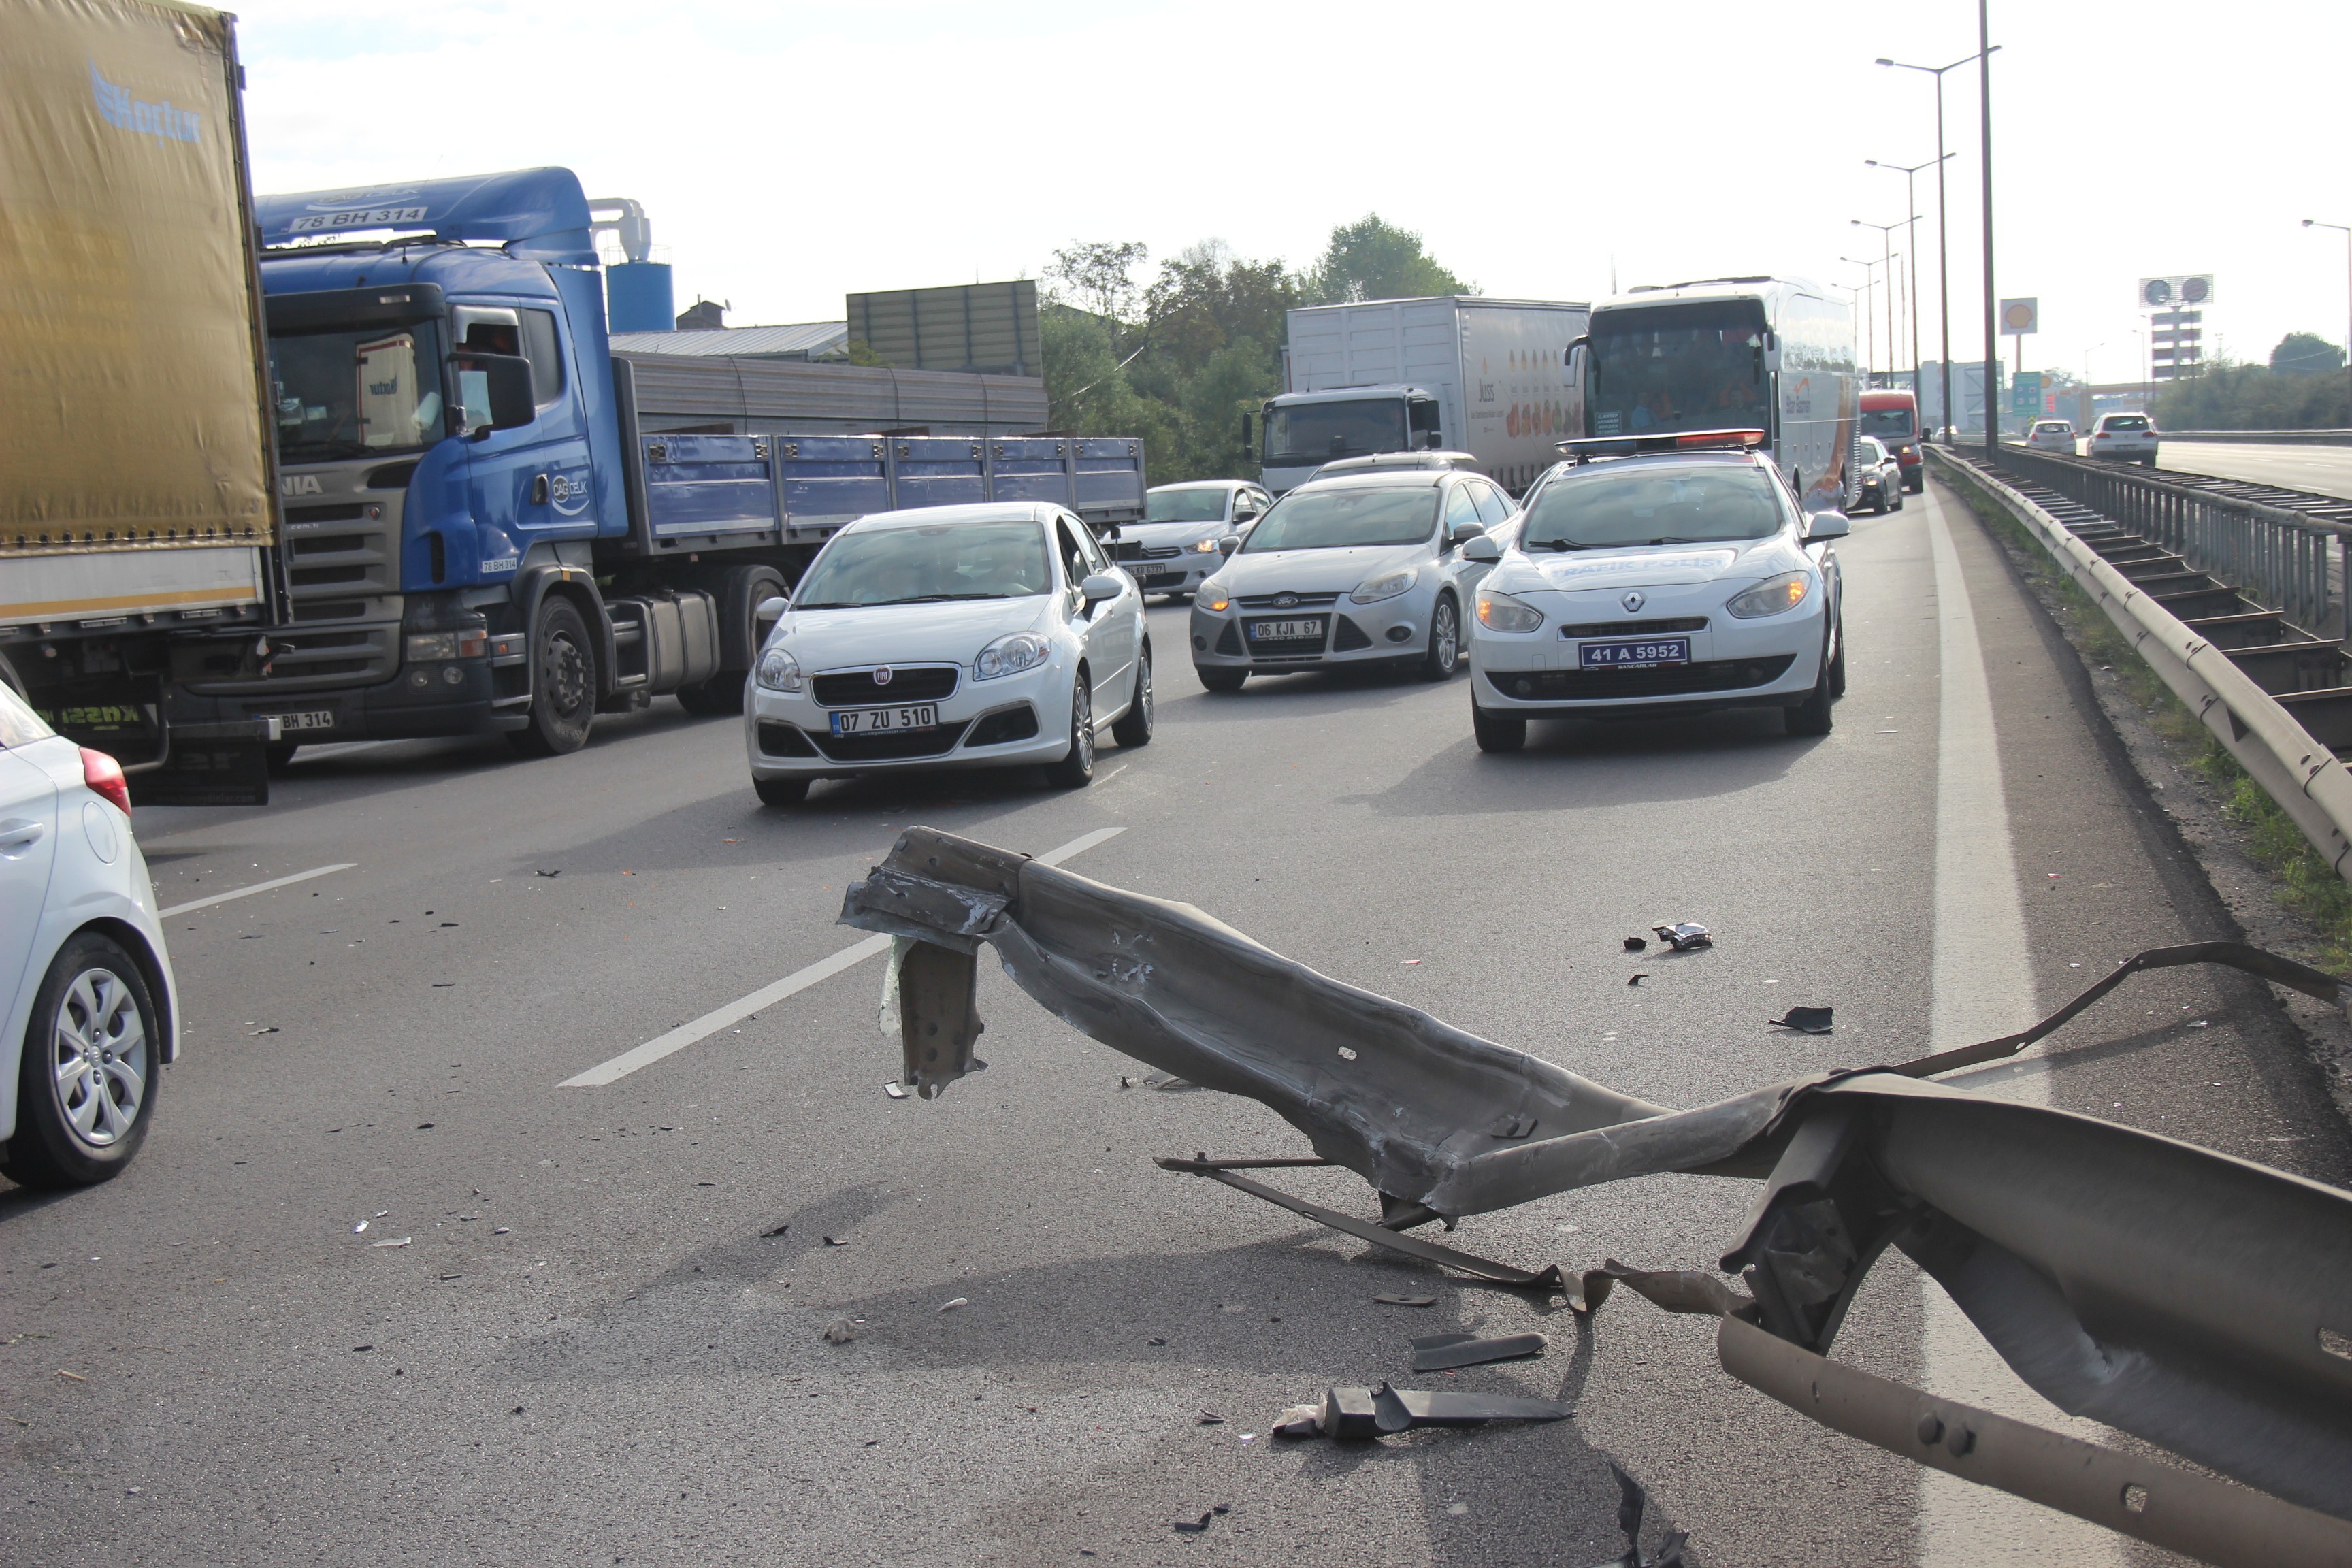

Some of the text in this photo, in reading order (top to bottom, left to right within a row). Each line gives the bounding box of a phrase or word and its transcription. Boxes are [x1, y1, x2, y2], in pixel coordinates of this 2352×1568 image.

[297, 208, 420, 230] 78 BH 314
[282, 475, 323, 496] NIA
[484, 559, 516, 572] 78 BH 314
[1259, 621, 1316, 636] 06 KJA 67
[1591, 644, 1679, 661] 41 A 5952
[877, 671, 888, 681] FIAT
[282, 713, 330, 729] BH 314
[840, 708, 931, 731] 07 ZU 510
